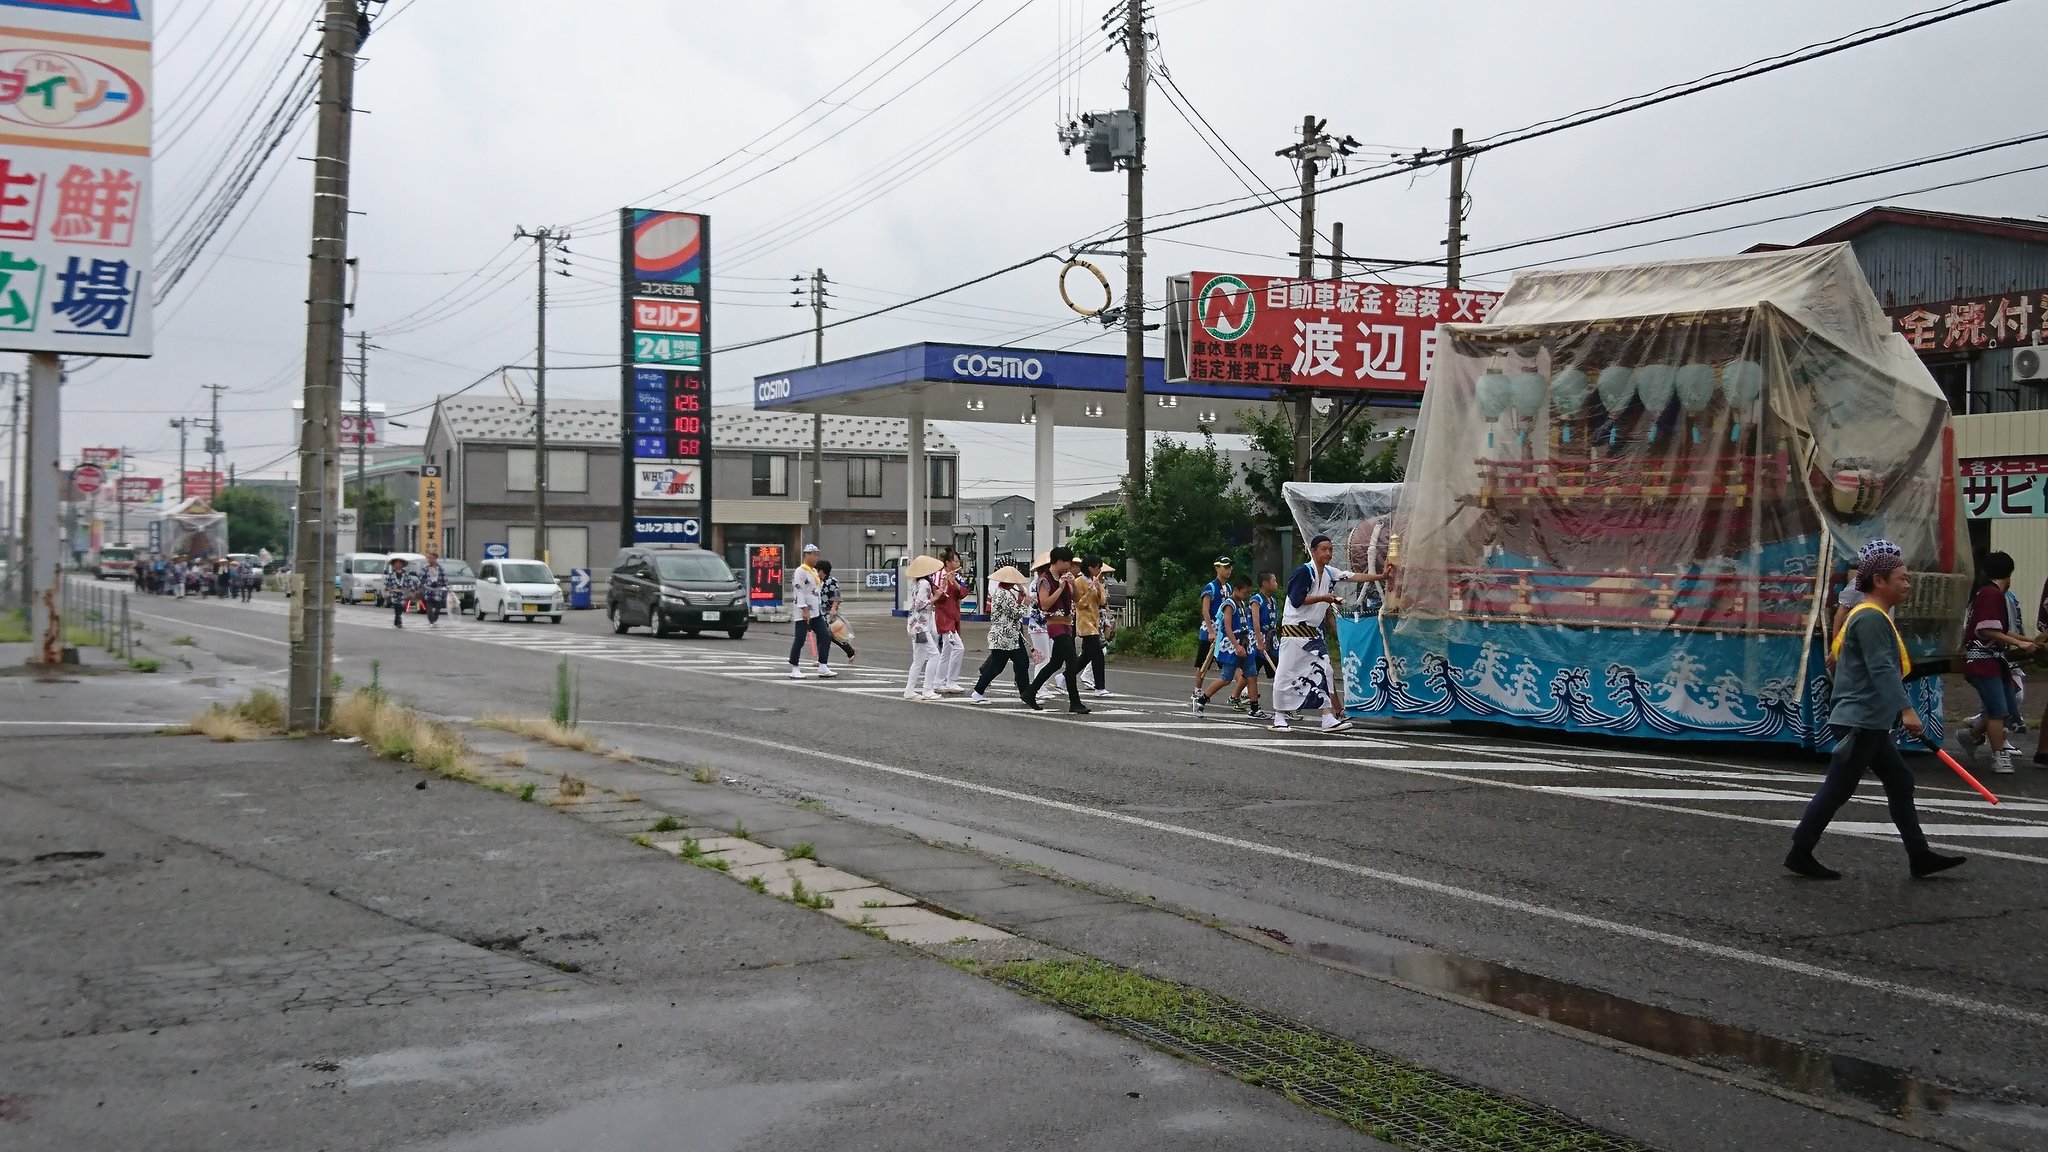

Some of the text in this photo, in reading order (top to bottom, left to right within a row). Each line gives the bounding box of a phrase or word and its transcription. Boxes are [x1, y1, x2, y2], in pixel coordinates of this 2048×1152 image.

[641, 282, 695, 296] コスモ石油
[637, 304, 699, 328] セルフ
[638, 337, 671, 360] 24
[1192, 341, 1284, 361] 車体整備協会
[953, 354, 1044, 381] COSMO
[1191, 359, 1292, 383] 指定推奨工場
[675, 375, 700, 390] 115
[758, 378, 791, 402] COSMO
[675, 394, 700, 411] 126
[675, 416, 700, 433] 100
[679, 439, 700, 455] 68
[1963, 474, 2048, 517] サビ
[635, 522, 683, 534] セルフ洗車
[757, 568, 782, 584] 114
[866, 573, 890, 587] 洗車
